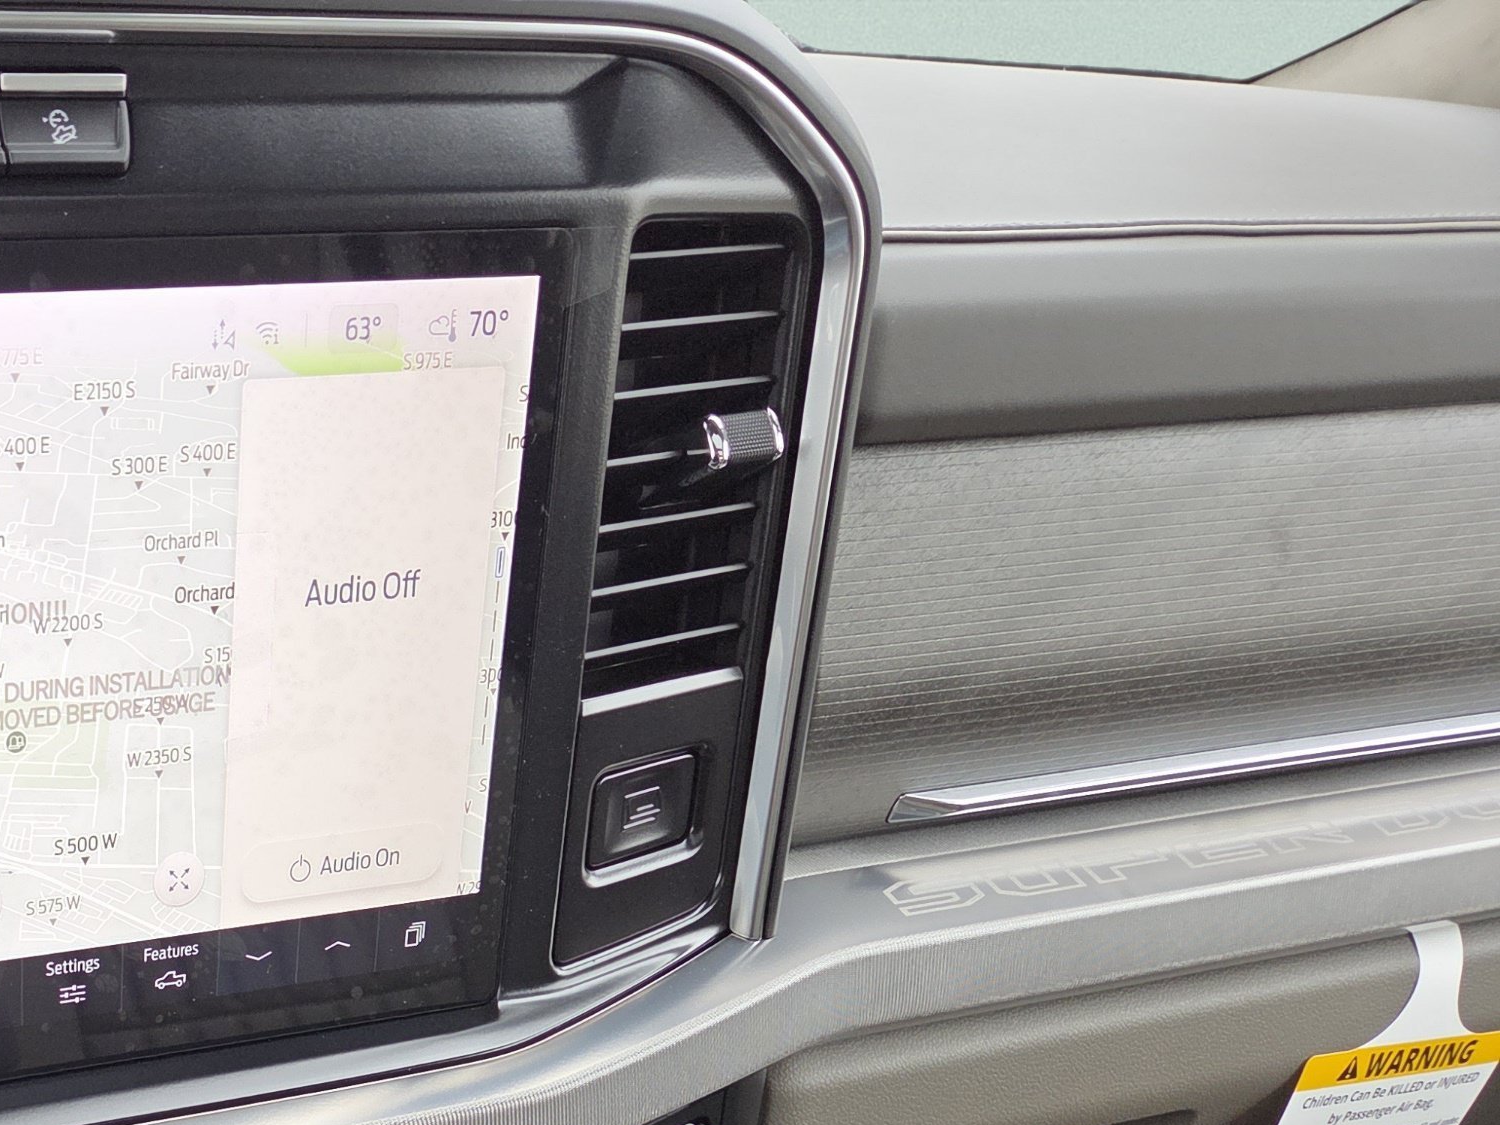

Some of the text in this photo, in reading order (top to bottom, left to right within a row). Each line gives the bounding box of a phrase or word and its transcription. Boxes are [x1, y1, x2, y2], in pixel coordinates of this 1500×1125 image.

[172, 361, 250, 382] Fairway Dr
[74, 381, 135, 401] E 2150 S
[4, 438, 36, 456] 400
[41, 437, 49, 453] E
[112, 456, 168, 475] S 300 E
[144, 531, 218, 552] Orchard Pl
[175, 582, 235, 604] Orchard
[305, 569, 421, 607] Audio Off
[34, 613, 104, 634] W 2200 S
[5, 677, 84, 704] DURING
[90, 664, 231, 696] INSTALLATION
[54, 833, 118, 855] S 500 W
[320, 848, 400, 876] Audio On
[143, 942, 199, 962] Features
[45, 956, 101, 977] Settings
[1365, 1040, 1479, 1078] WARNING
[1302, 1071, 1480, 1109] Children Can Be KILLED or INJURED
[1342, 1104, 1397, 1123] Passenger
[1396, 1100, 1412, 1113] Air
